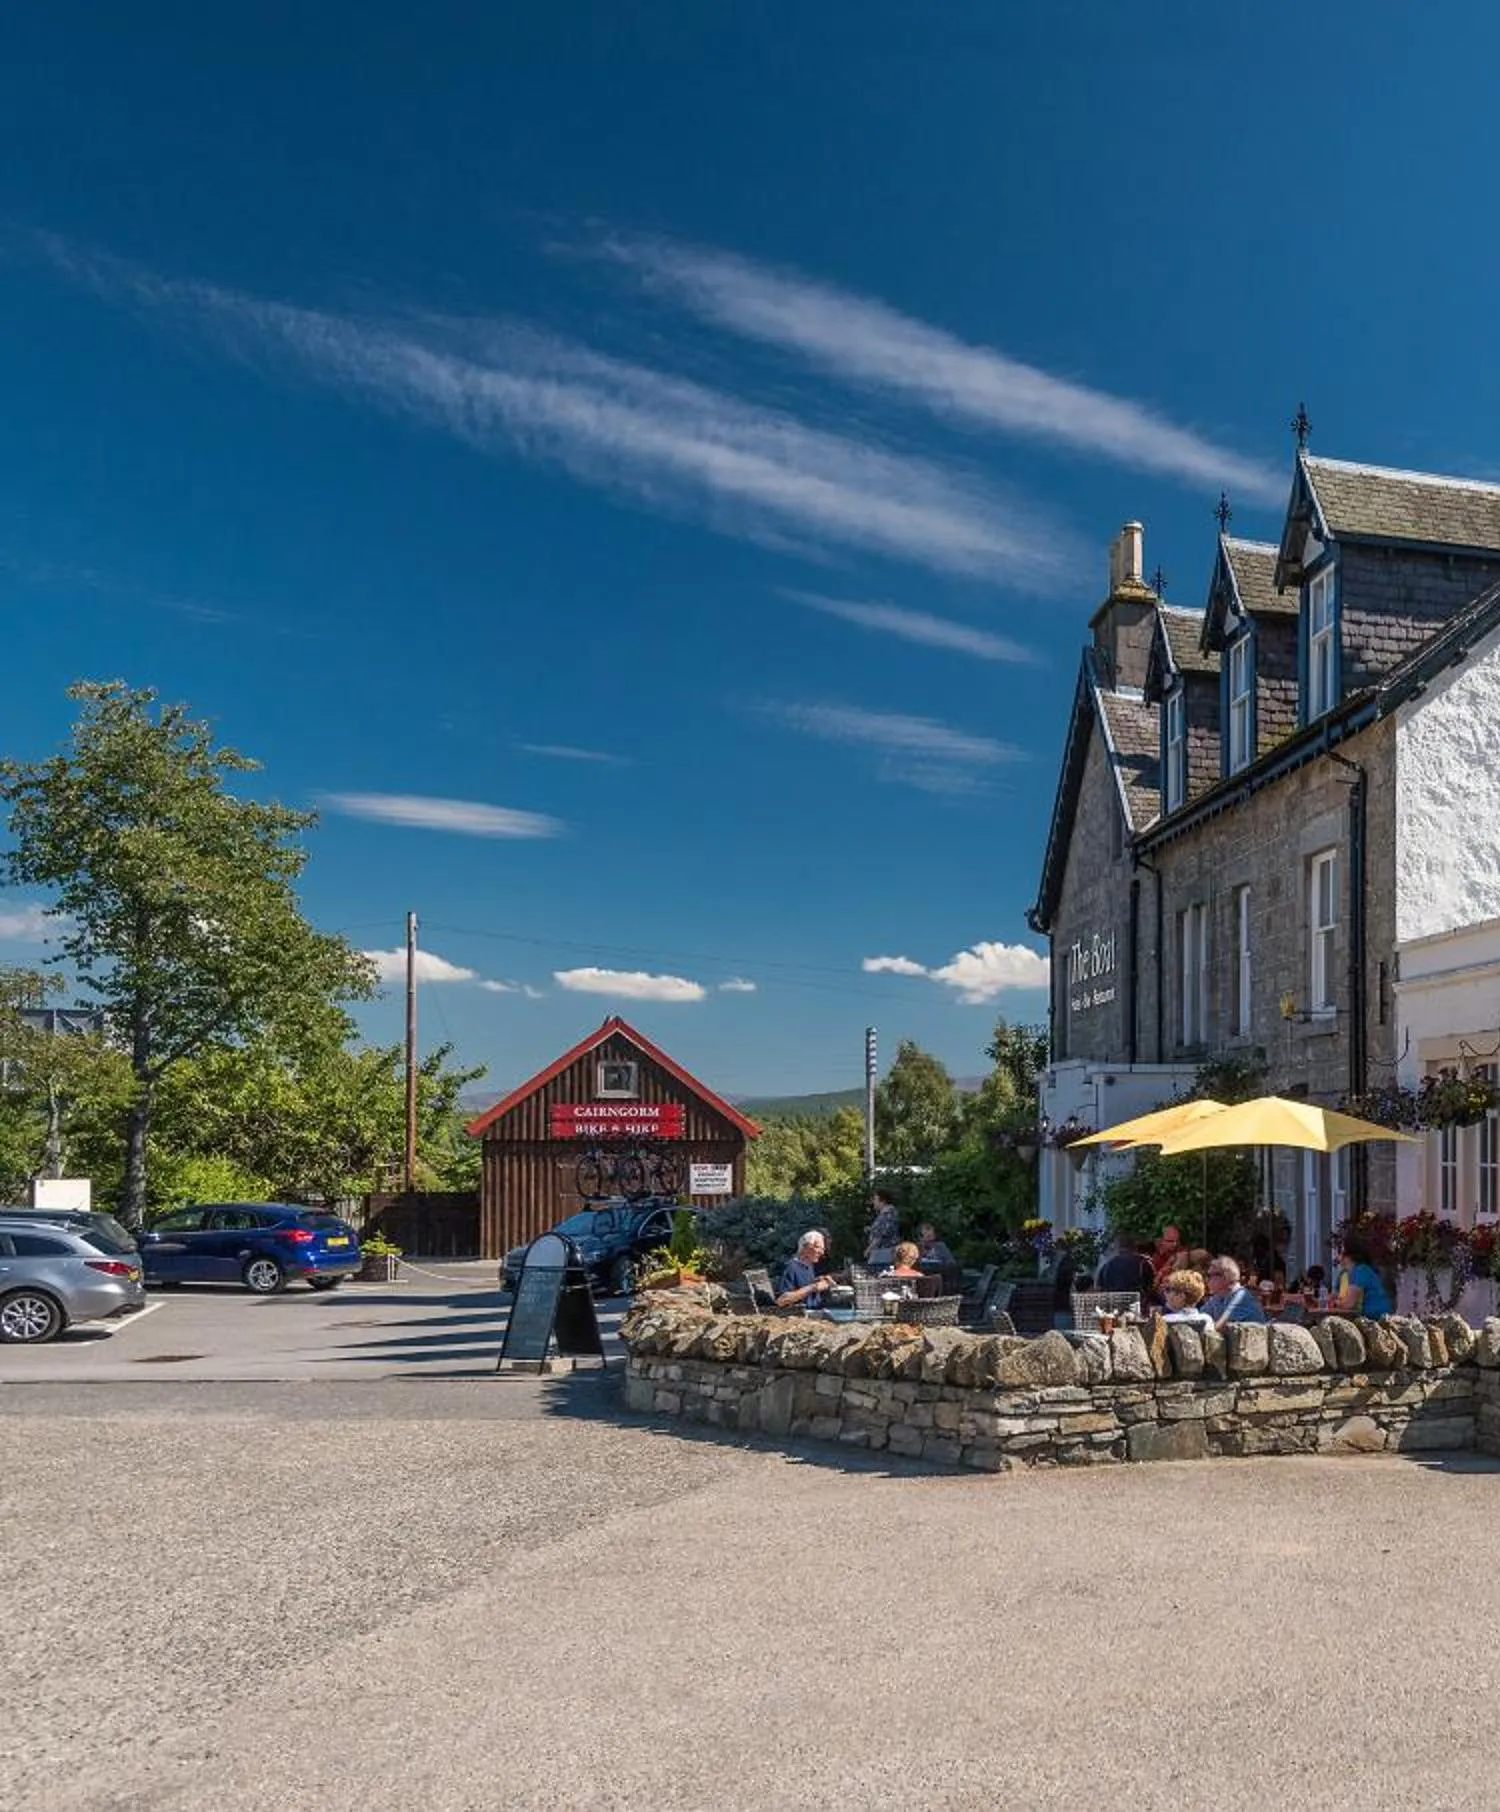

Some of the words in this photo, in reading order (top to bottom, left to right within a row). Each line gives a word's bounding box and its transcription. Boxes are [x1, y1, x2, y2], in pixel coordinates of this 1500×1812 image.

[1071, 938, 1089, 984] The
[573, 1106, 659, 1117] CAIRNGORM
[575, 1123, 606, 1136] BIKE
